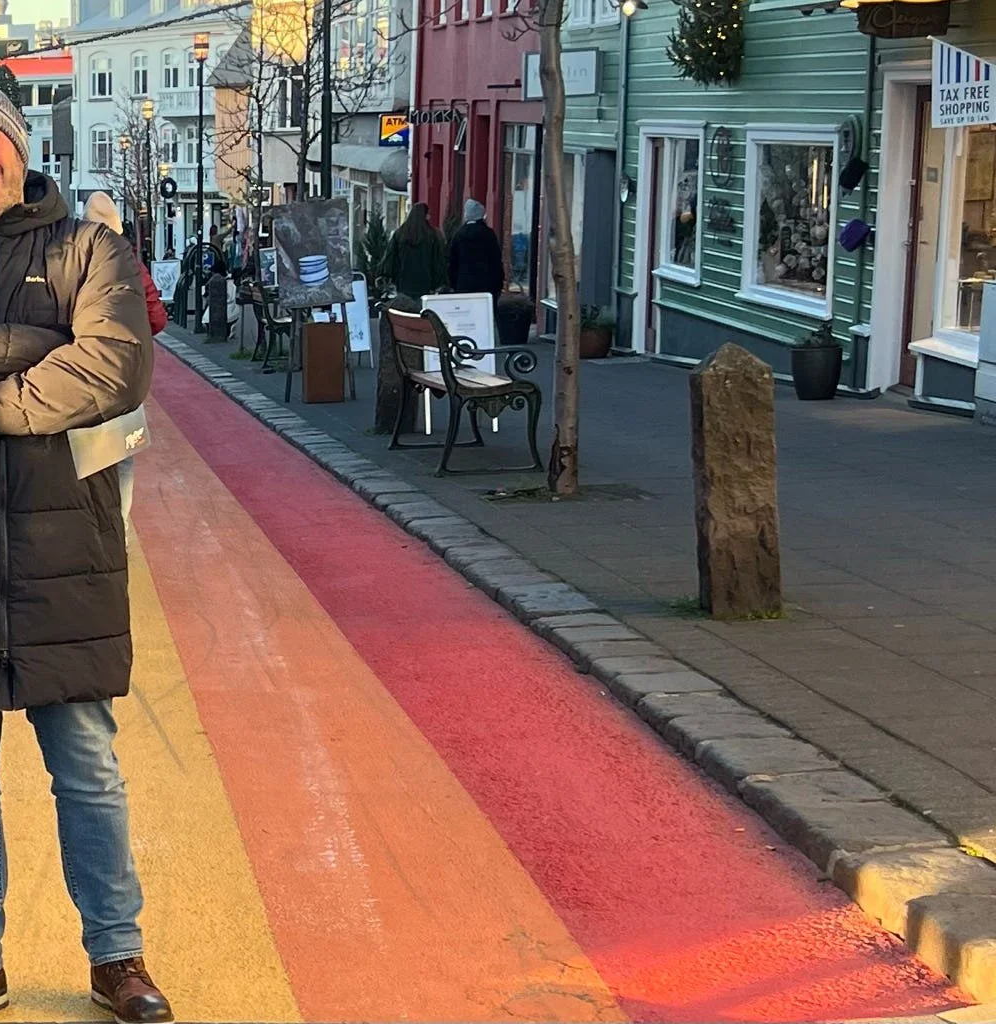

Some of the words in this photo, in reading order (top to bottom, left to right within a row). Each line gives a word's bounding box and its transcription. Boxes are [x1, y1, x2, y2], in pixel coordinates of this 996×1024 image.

[940, 87, 960, 102] TAX
[964, 85, 990, 99] FREE
[939, 100, 990, 116] SHOPPING
[386, 117, 408, 126] ATM
[409, 109, 462, 127] MOKKA
